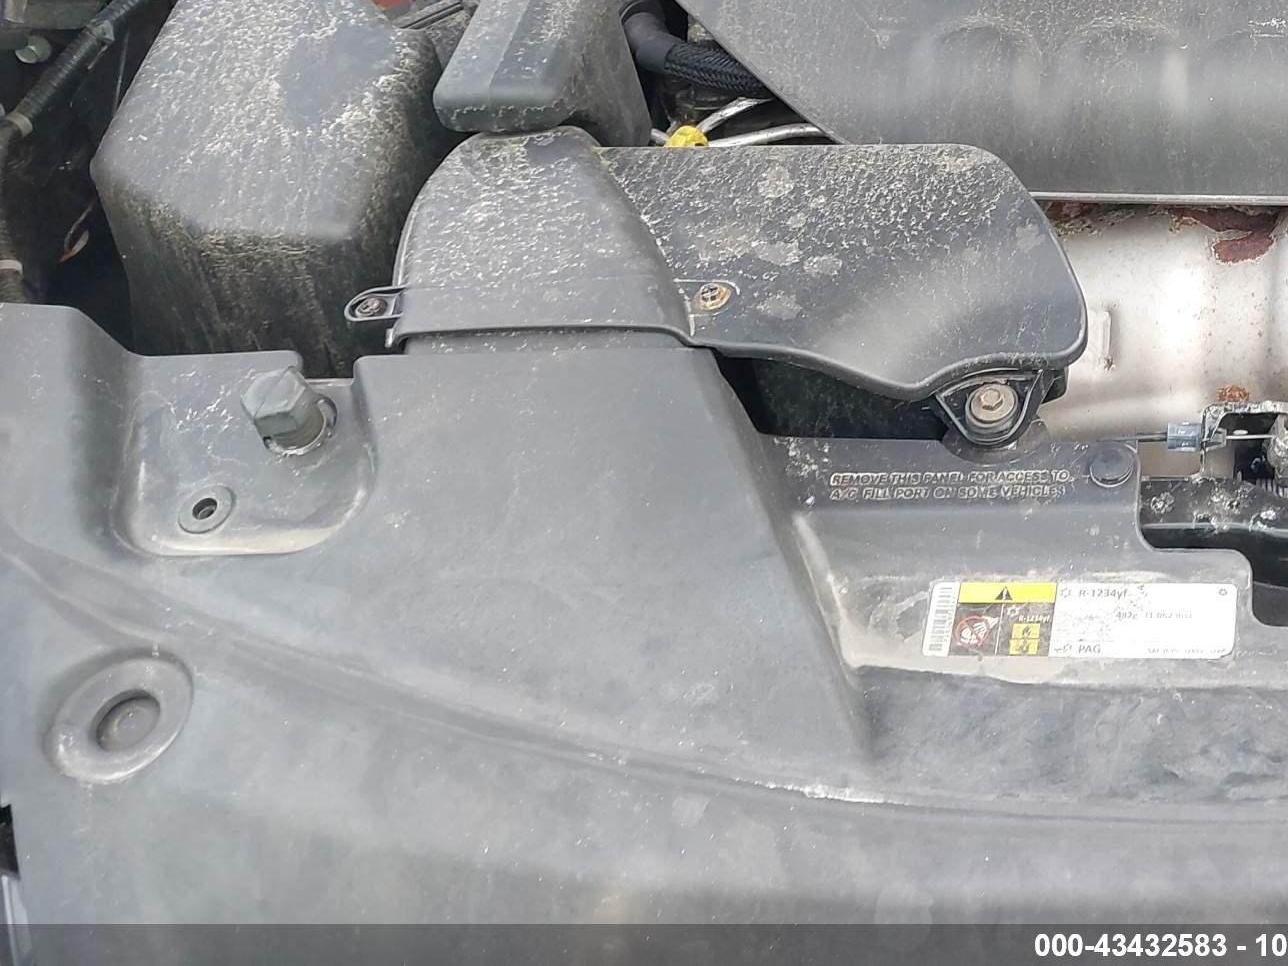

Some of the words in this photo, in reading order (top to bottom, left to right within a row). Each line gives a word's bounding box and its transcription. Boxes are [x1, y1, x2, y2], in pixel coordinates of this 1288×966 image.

[830, 472, 889, 486] REMOVE
[890, 472, 920, 485] THIS
[922, 472, 963, 485] PANEL
[967, 471, 996, 484] FOR
[997, 470, 1049, 483] ACCESS
[829, 487, 858, 500] A/C
[862, 487, 891, 500] FILL
[895, 487, 930, 499] PORT
[959, 486, 999, 499] SOME
[1000, 484, 1066, 498] VEHICLES
[1078, 644, 1101, 654] PAG
